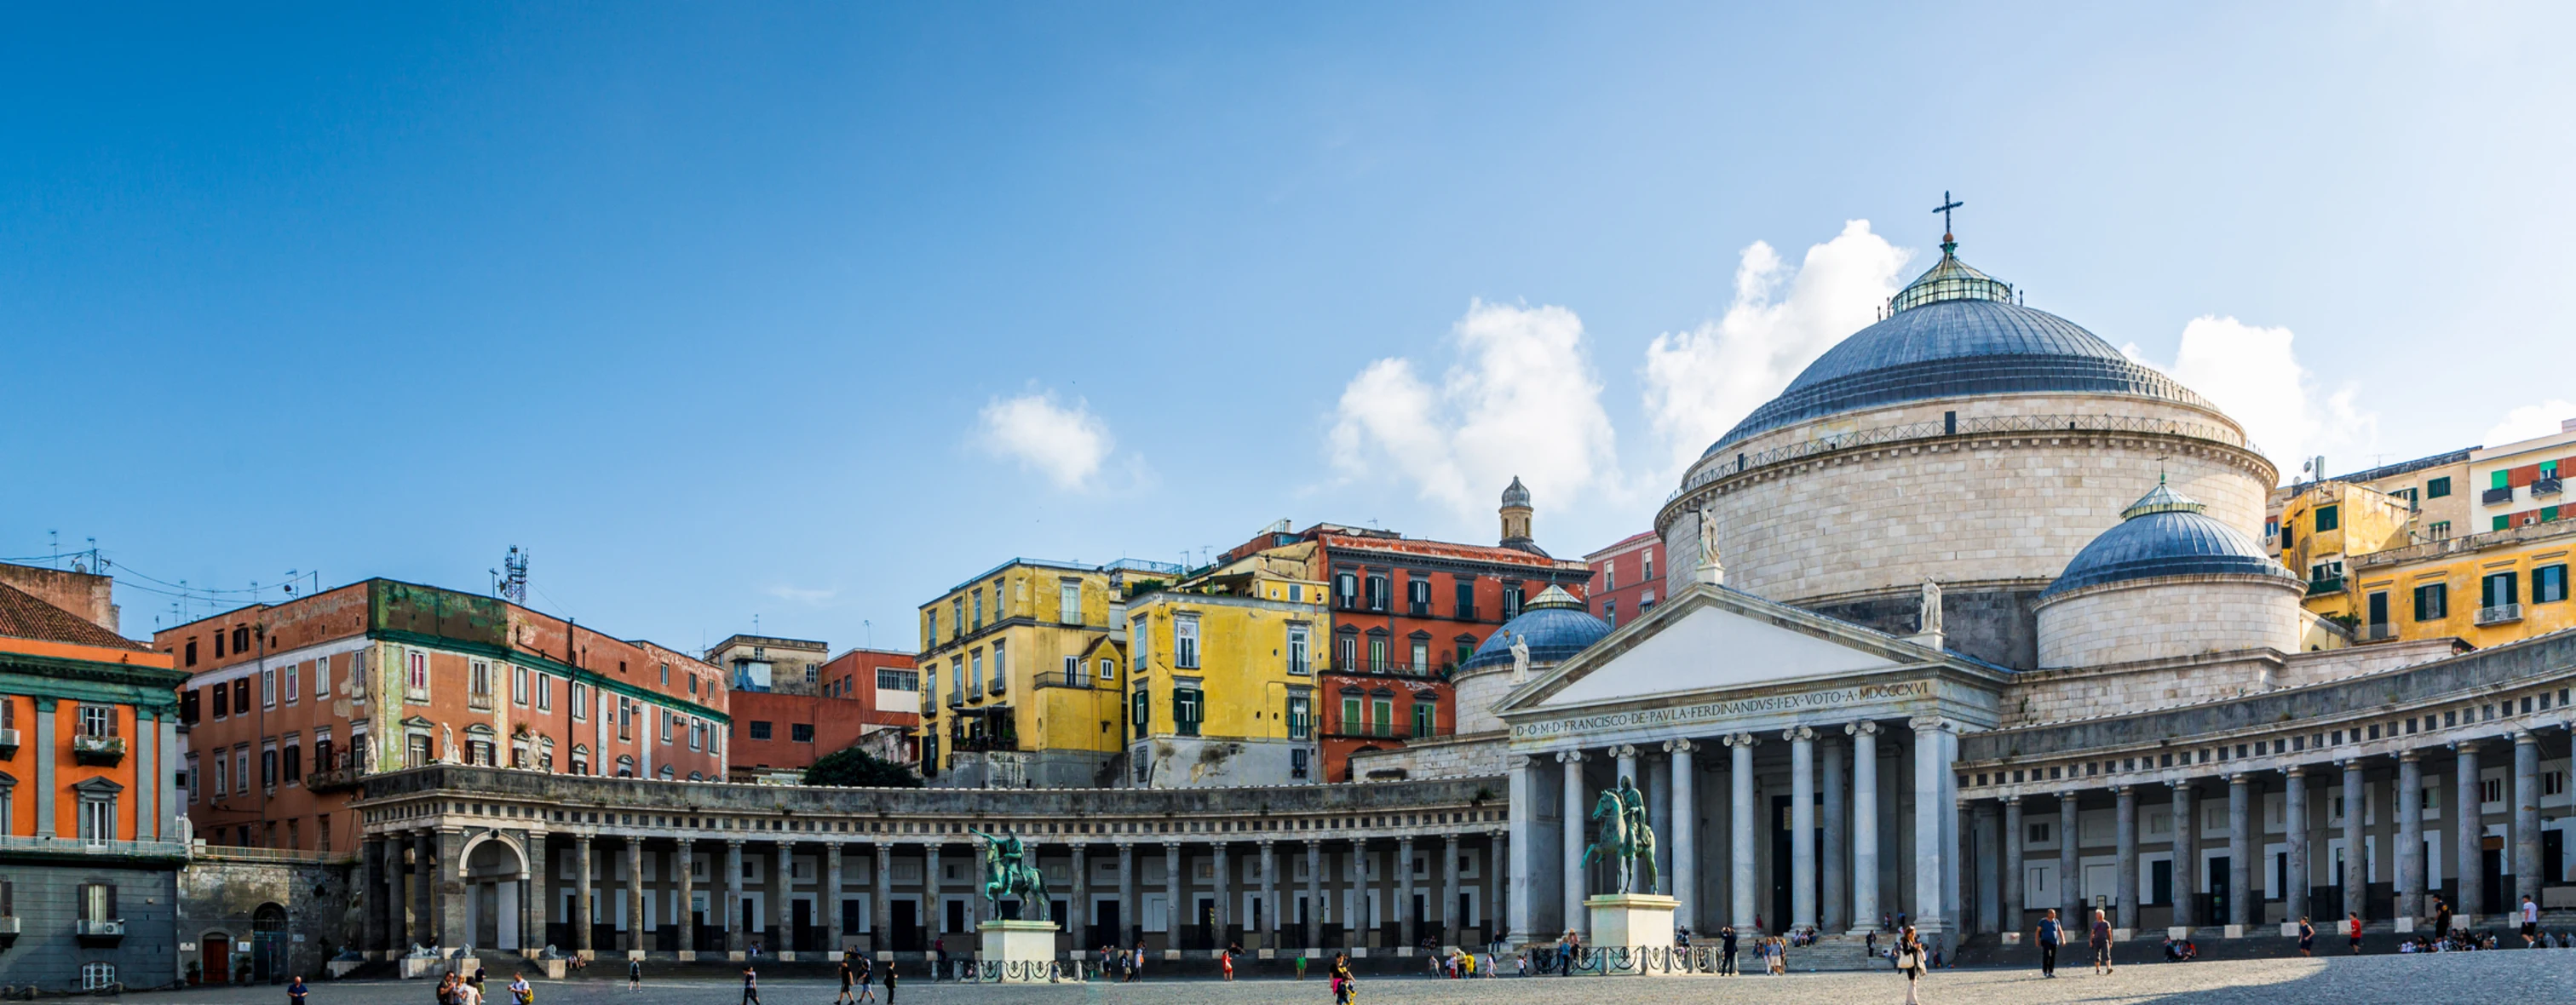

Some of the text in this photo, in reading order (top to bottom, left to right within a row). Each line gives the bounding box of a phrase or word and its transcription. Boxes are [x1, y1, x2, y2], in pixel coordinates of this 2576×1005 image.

[1564, 715, 1627, 731] FRANCISCO
[1631, 712, 1646, 723] DE
[1650, 709, 1687, 722] PAVLA
[1691, 698, 1774, 718] FERDINANDVS
[1784, 696, 1800, 708] EX
[1804, 692, 1841, 705] VOTO
[1845, 690, 1854, 702] A
[1859, 681, 1928, 699] MDCCCXVI
